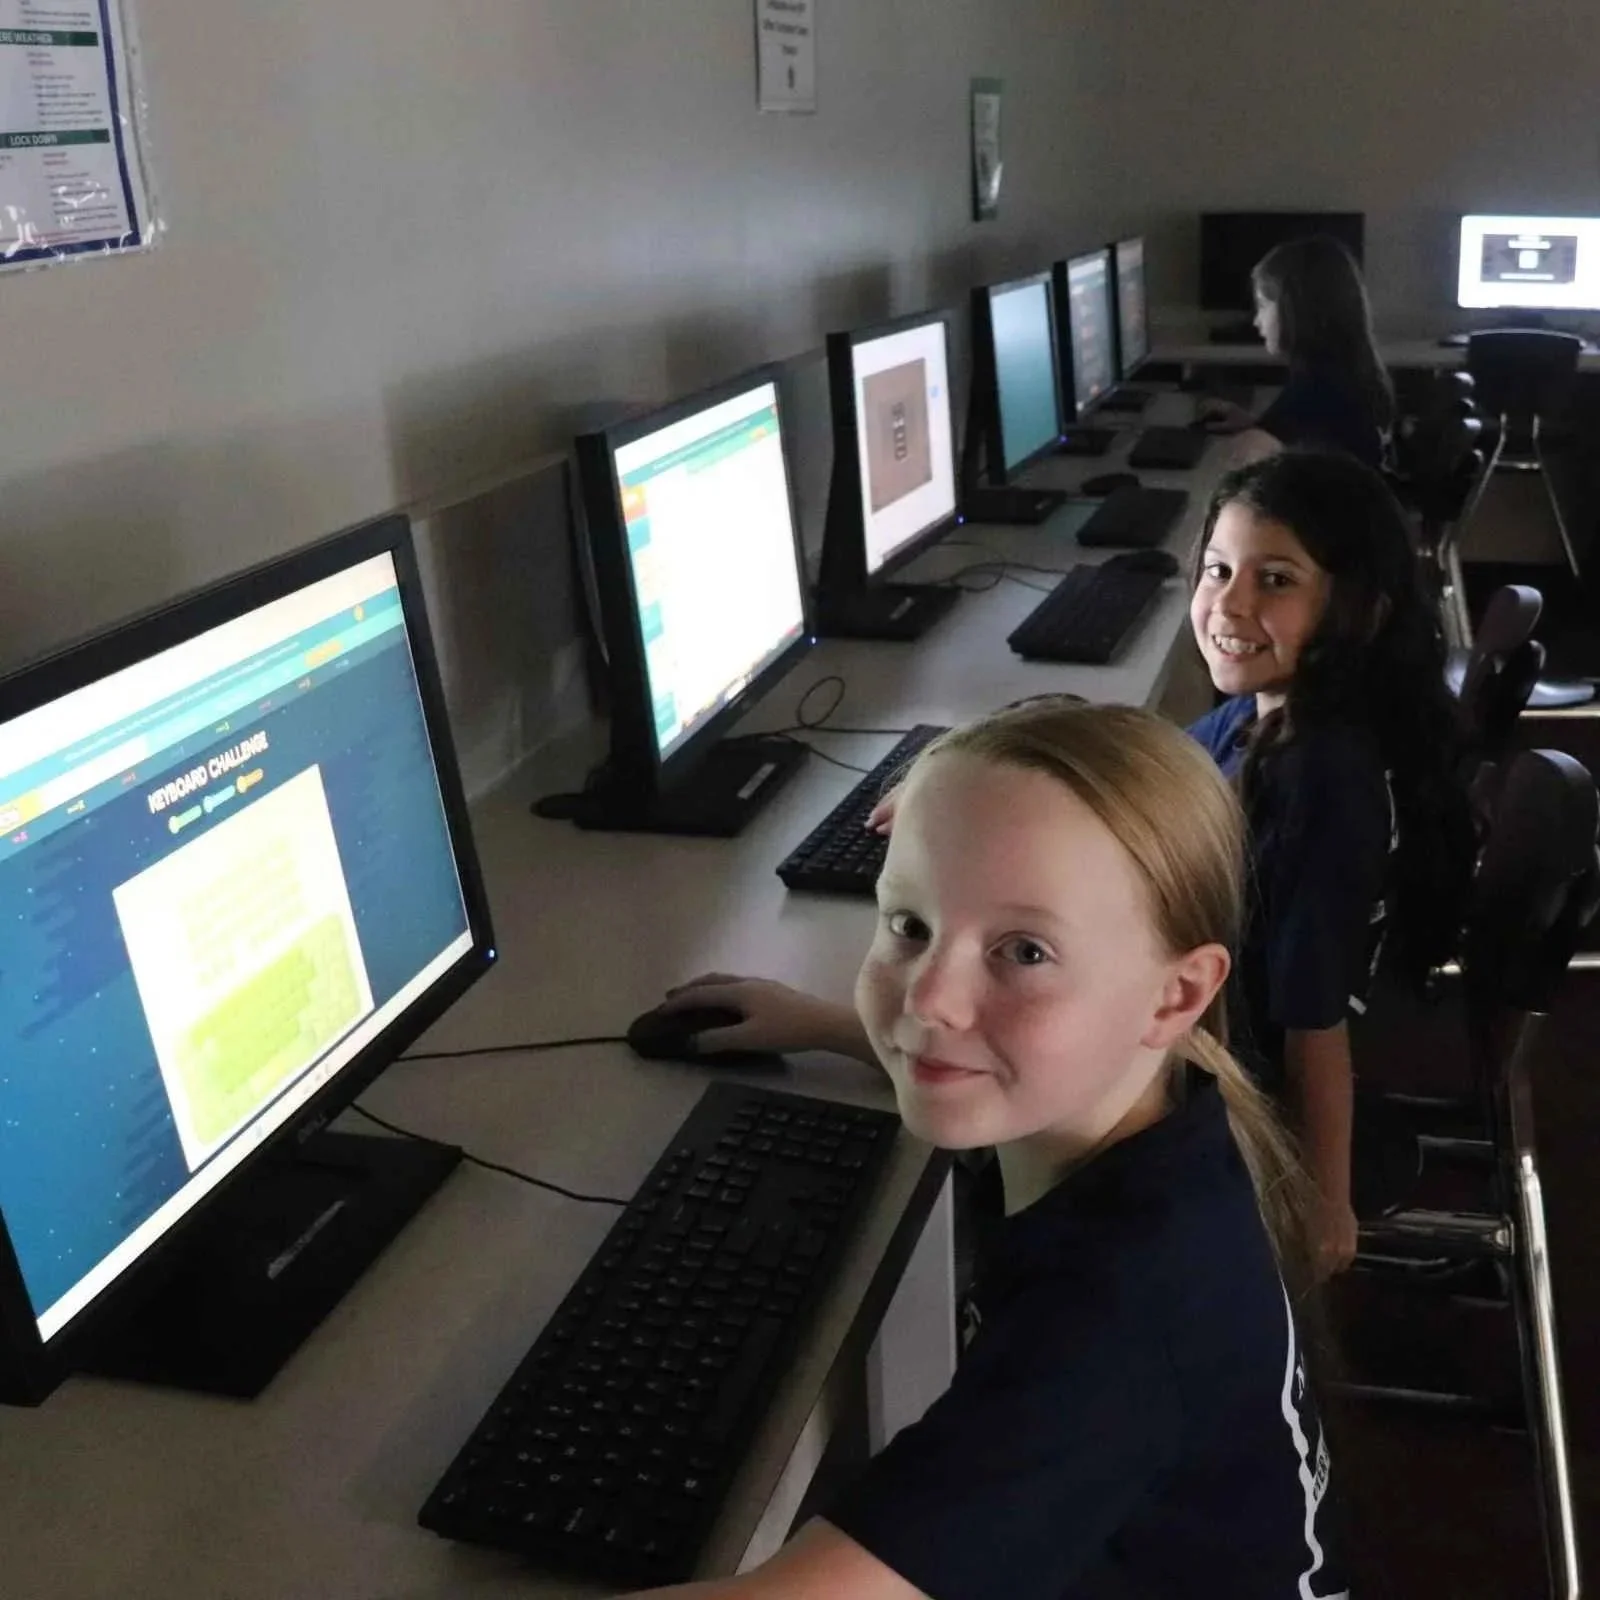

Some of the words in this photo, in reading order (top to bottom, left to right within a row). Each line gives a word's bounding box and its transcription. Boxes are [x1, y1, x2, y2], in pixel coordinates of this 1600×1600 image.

[9, 135, 31, 146] LOCK
[32, 133, 58, 145] DOWN
[147, 766, 209, 814] KEYBOARD
[208, 730, 269, 778] CHALLENGE
